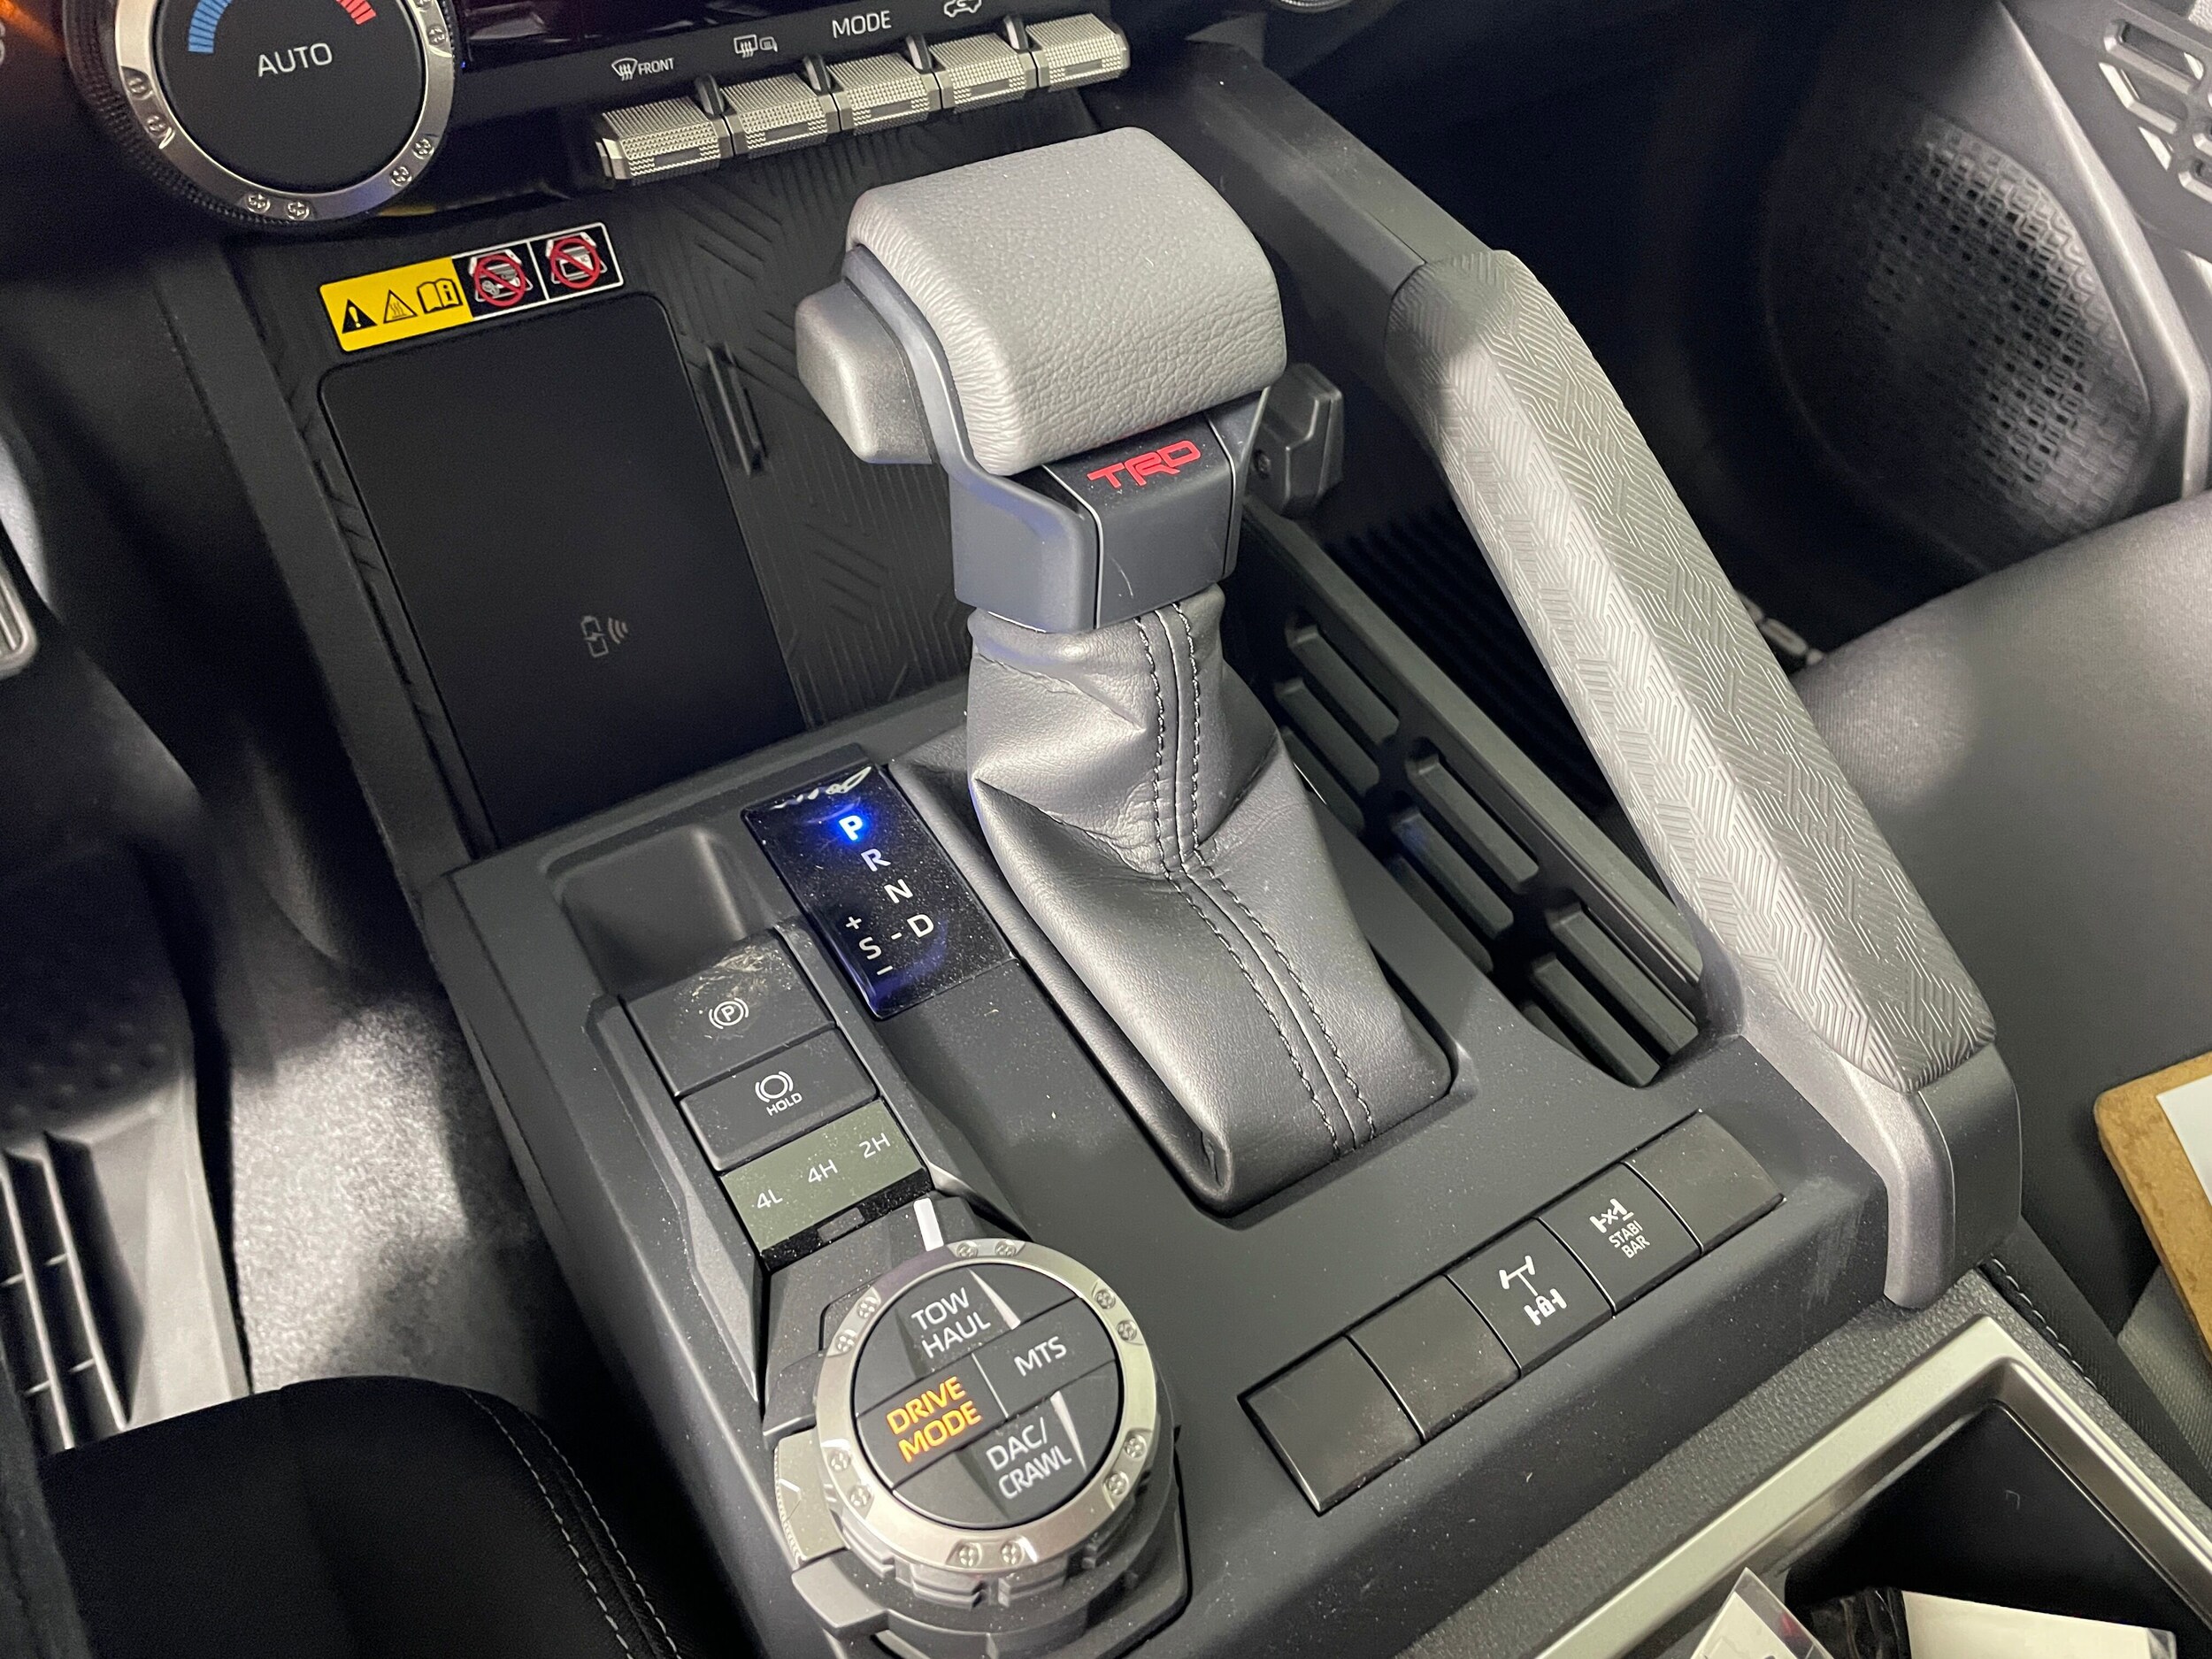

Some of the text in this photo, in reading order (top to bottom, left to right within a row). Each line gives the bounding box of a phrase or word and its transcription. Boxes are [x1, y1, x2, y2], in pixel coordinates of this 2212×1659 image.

[832, 11, 892, 38] MODE
[257, 42, 333, 77] AUTO
[637, 58, 675, 74] FRONT
[1087, 440, 1202, 488] TRD
[839, 815, 864, 841] P
[861, 848, 891, 872] R
[884, 879, 913, 903] N
[858, 936, 882, 960] S
[906, 914, 934, 938] D
[721, 1005, 735, 1022] P
[765, 1092, 803, 1117] HOLD
[757, 1133, 891, 1210] 4L 4H 2H
[1609, 1220, 1643, 1248] STABI
[1621, 1234, 1650, 1258] BAR
[911, 1287, 971, 1330] TOW
[921, 1312, 992, 1359] HAUL
[1013, 1335, 1068, 1377] MTS
[887, 1376, 967, 1435] DRIVE
[897, 1401, 982, 1463] MODE
[985, 1417, 1049, 1471] DAC/
[998, 1445, 1072, 1500] CRAWL
